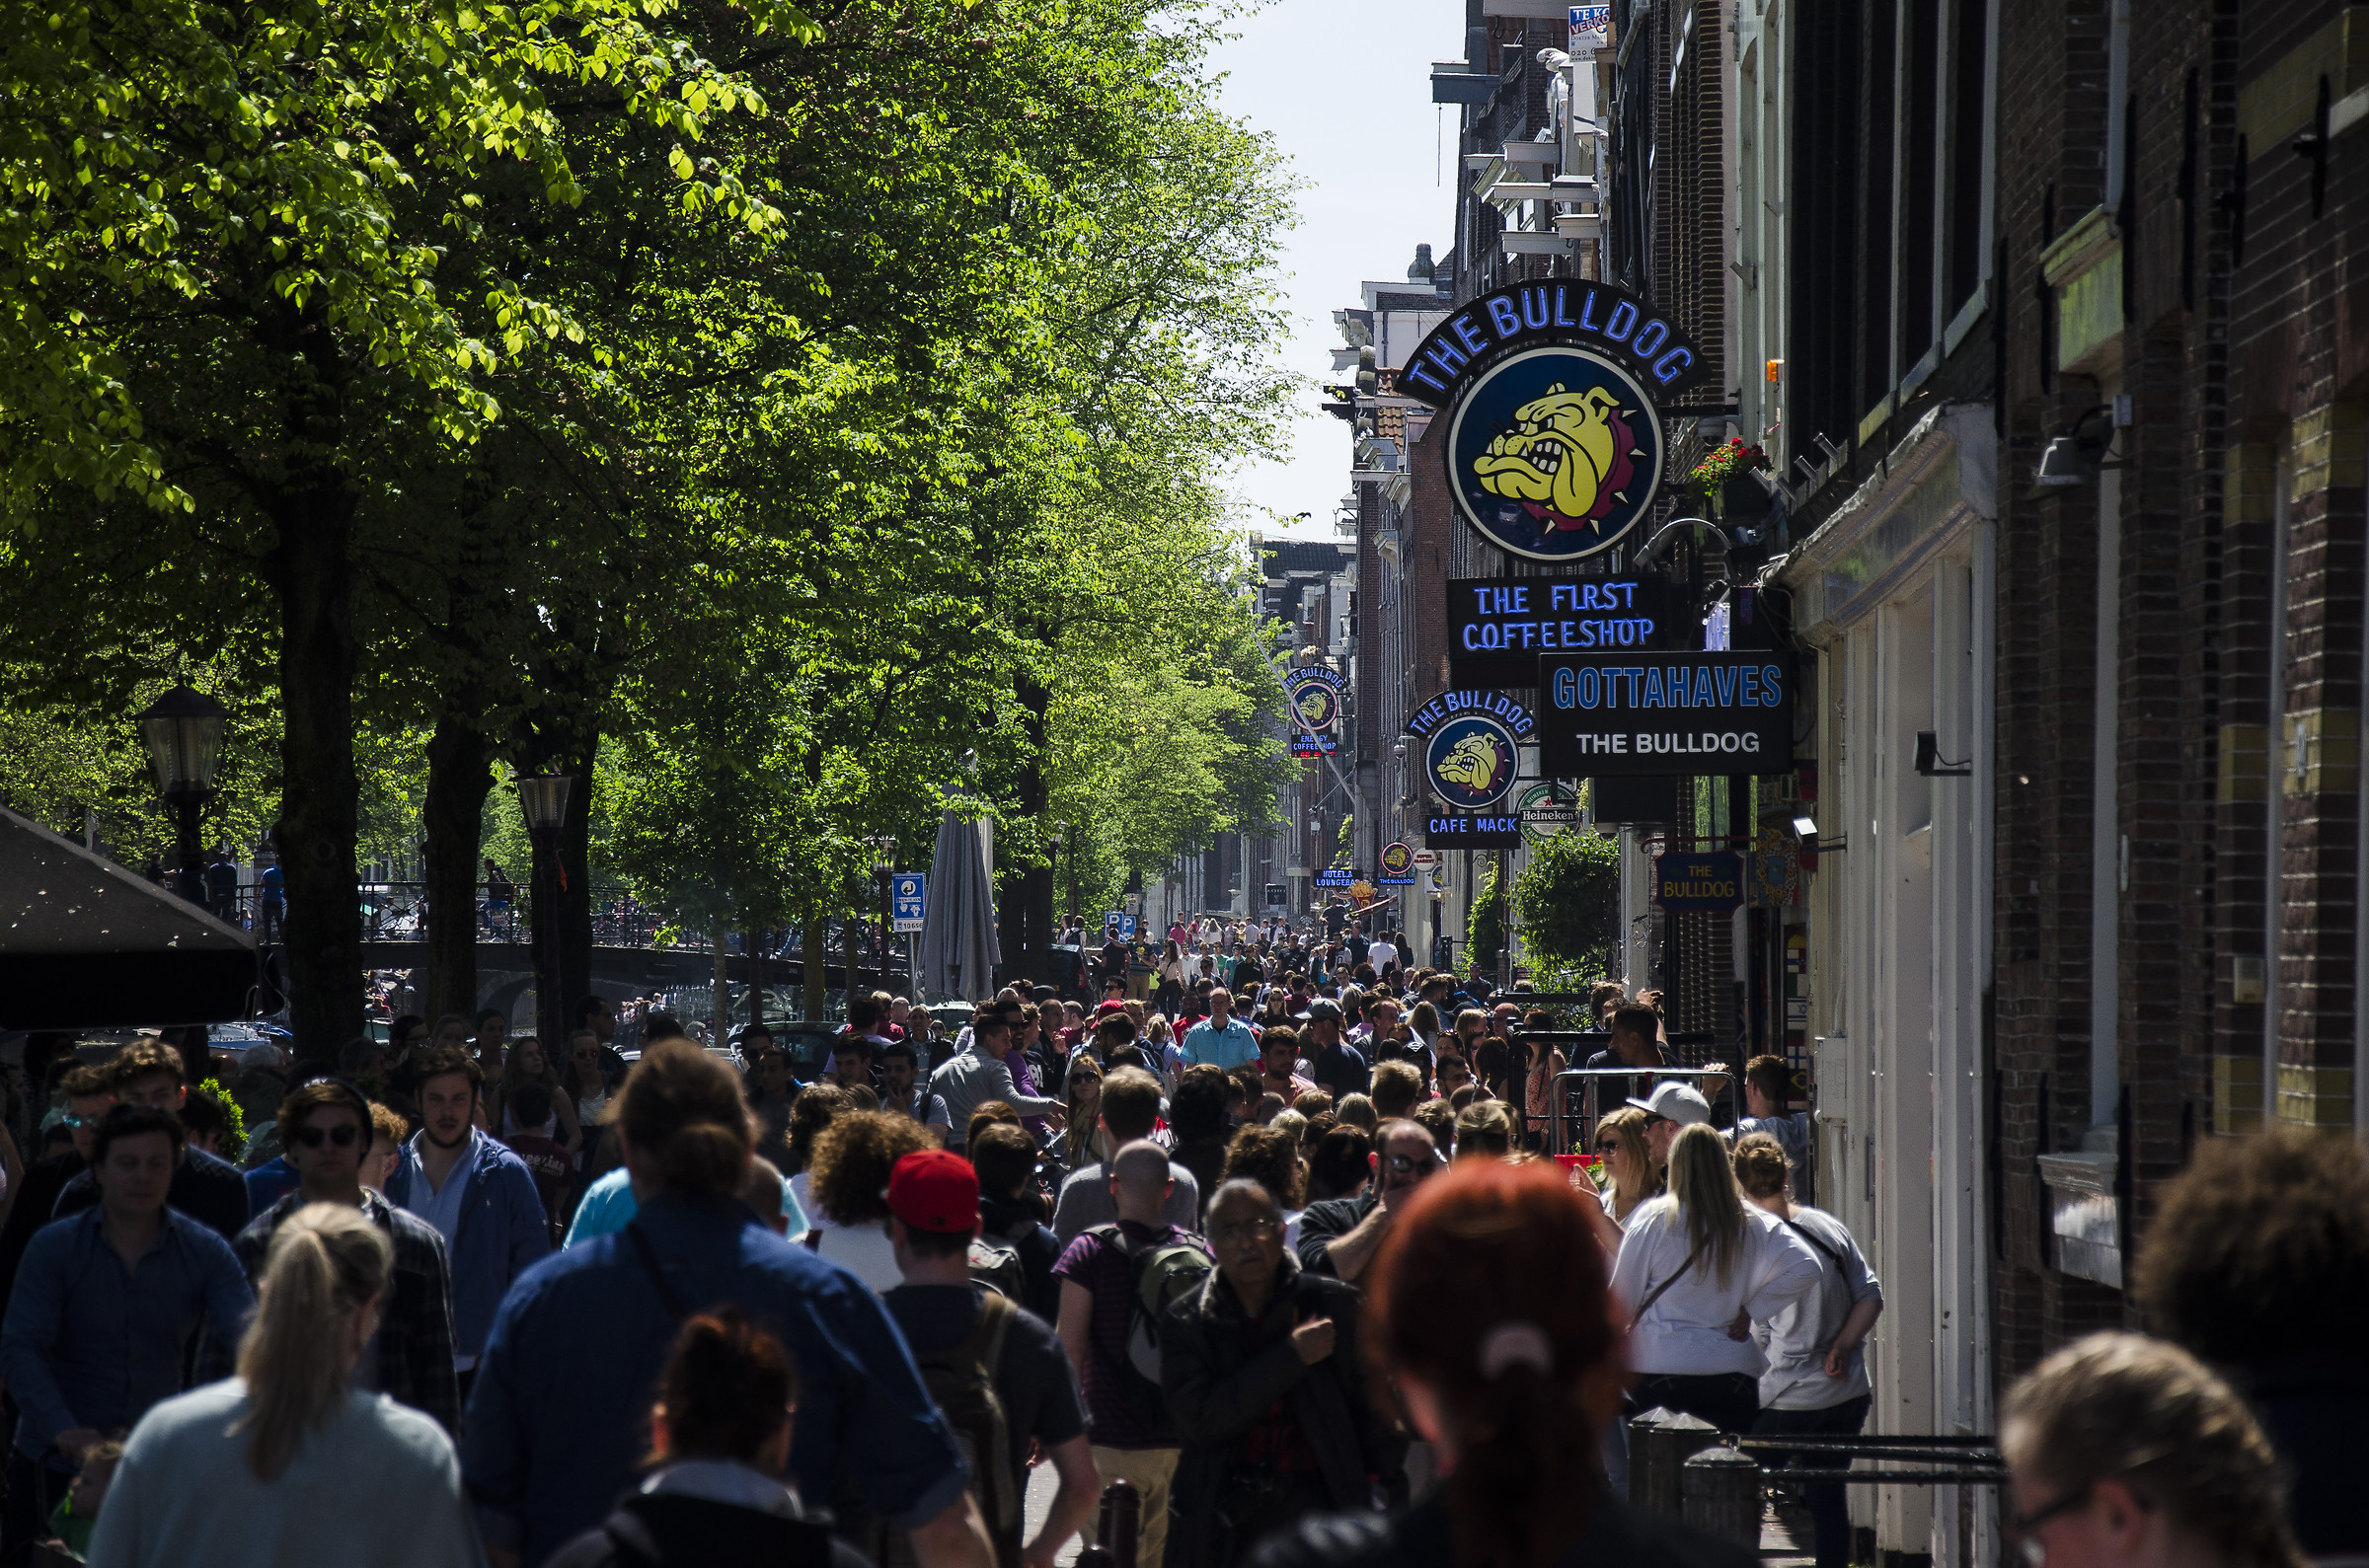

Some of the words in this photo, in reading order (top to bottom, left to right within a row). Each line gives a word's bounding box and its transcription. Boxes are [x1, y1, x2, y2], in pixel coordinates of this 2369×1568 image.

[1573, 9, 1590, 21] TE
[1406, 314, 1491, 393] THE
[1487, 286, 1694, 386] BULLDOG
[1474, 585, 1531, 615] THE
[1552, 581, 1639, 612] FIRST
[1462, 618, 1656, 651] COFFEESHOP
[1300, 667, 1345, 690] BULLDOG
[1553, 664, 1783, 709] GOTTAHAVES
[1410, 698, 1445, 735] THE
[1445, 690, 1534, 734] BULLDOG
[1293, 742, 1337, 751] COFFEEHOP
[1576, 734, 1633, 754] THE
[1637, 732, 1761, 754] BULLDOG
[1429, 819, 1468, 834] CAFE
[1477, 818, 1518, 833] MACK
[1522, 810, 1574, 821] Heineken
[1688, 865, 1714, 877] THE
[1663, 881, 1735, 898] BULLDOG
